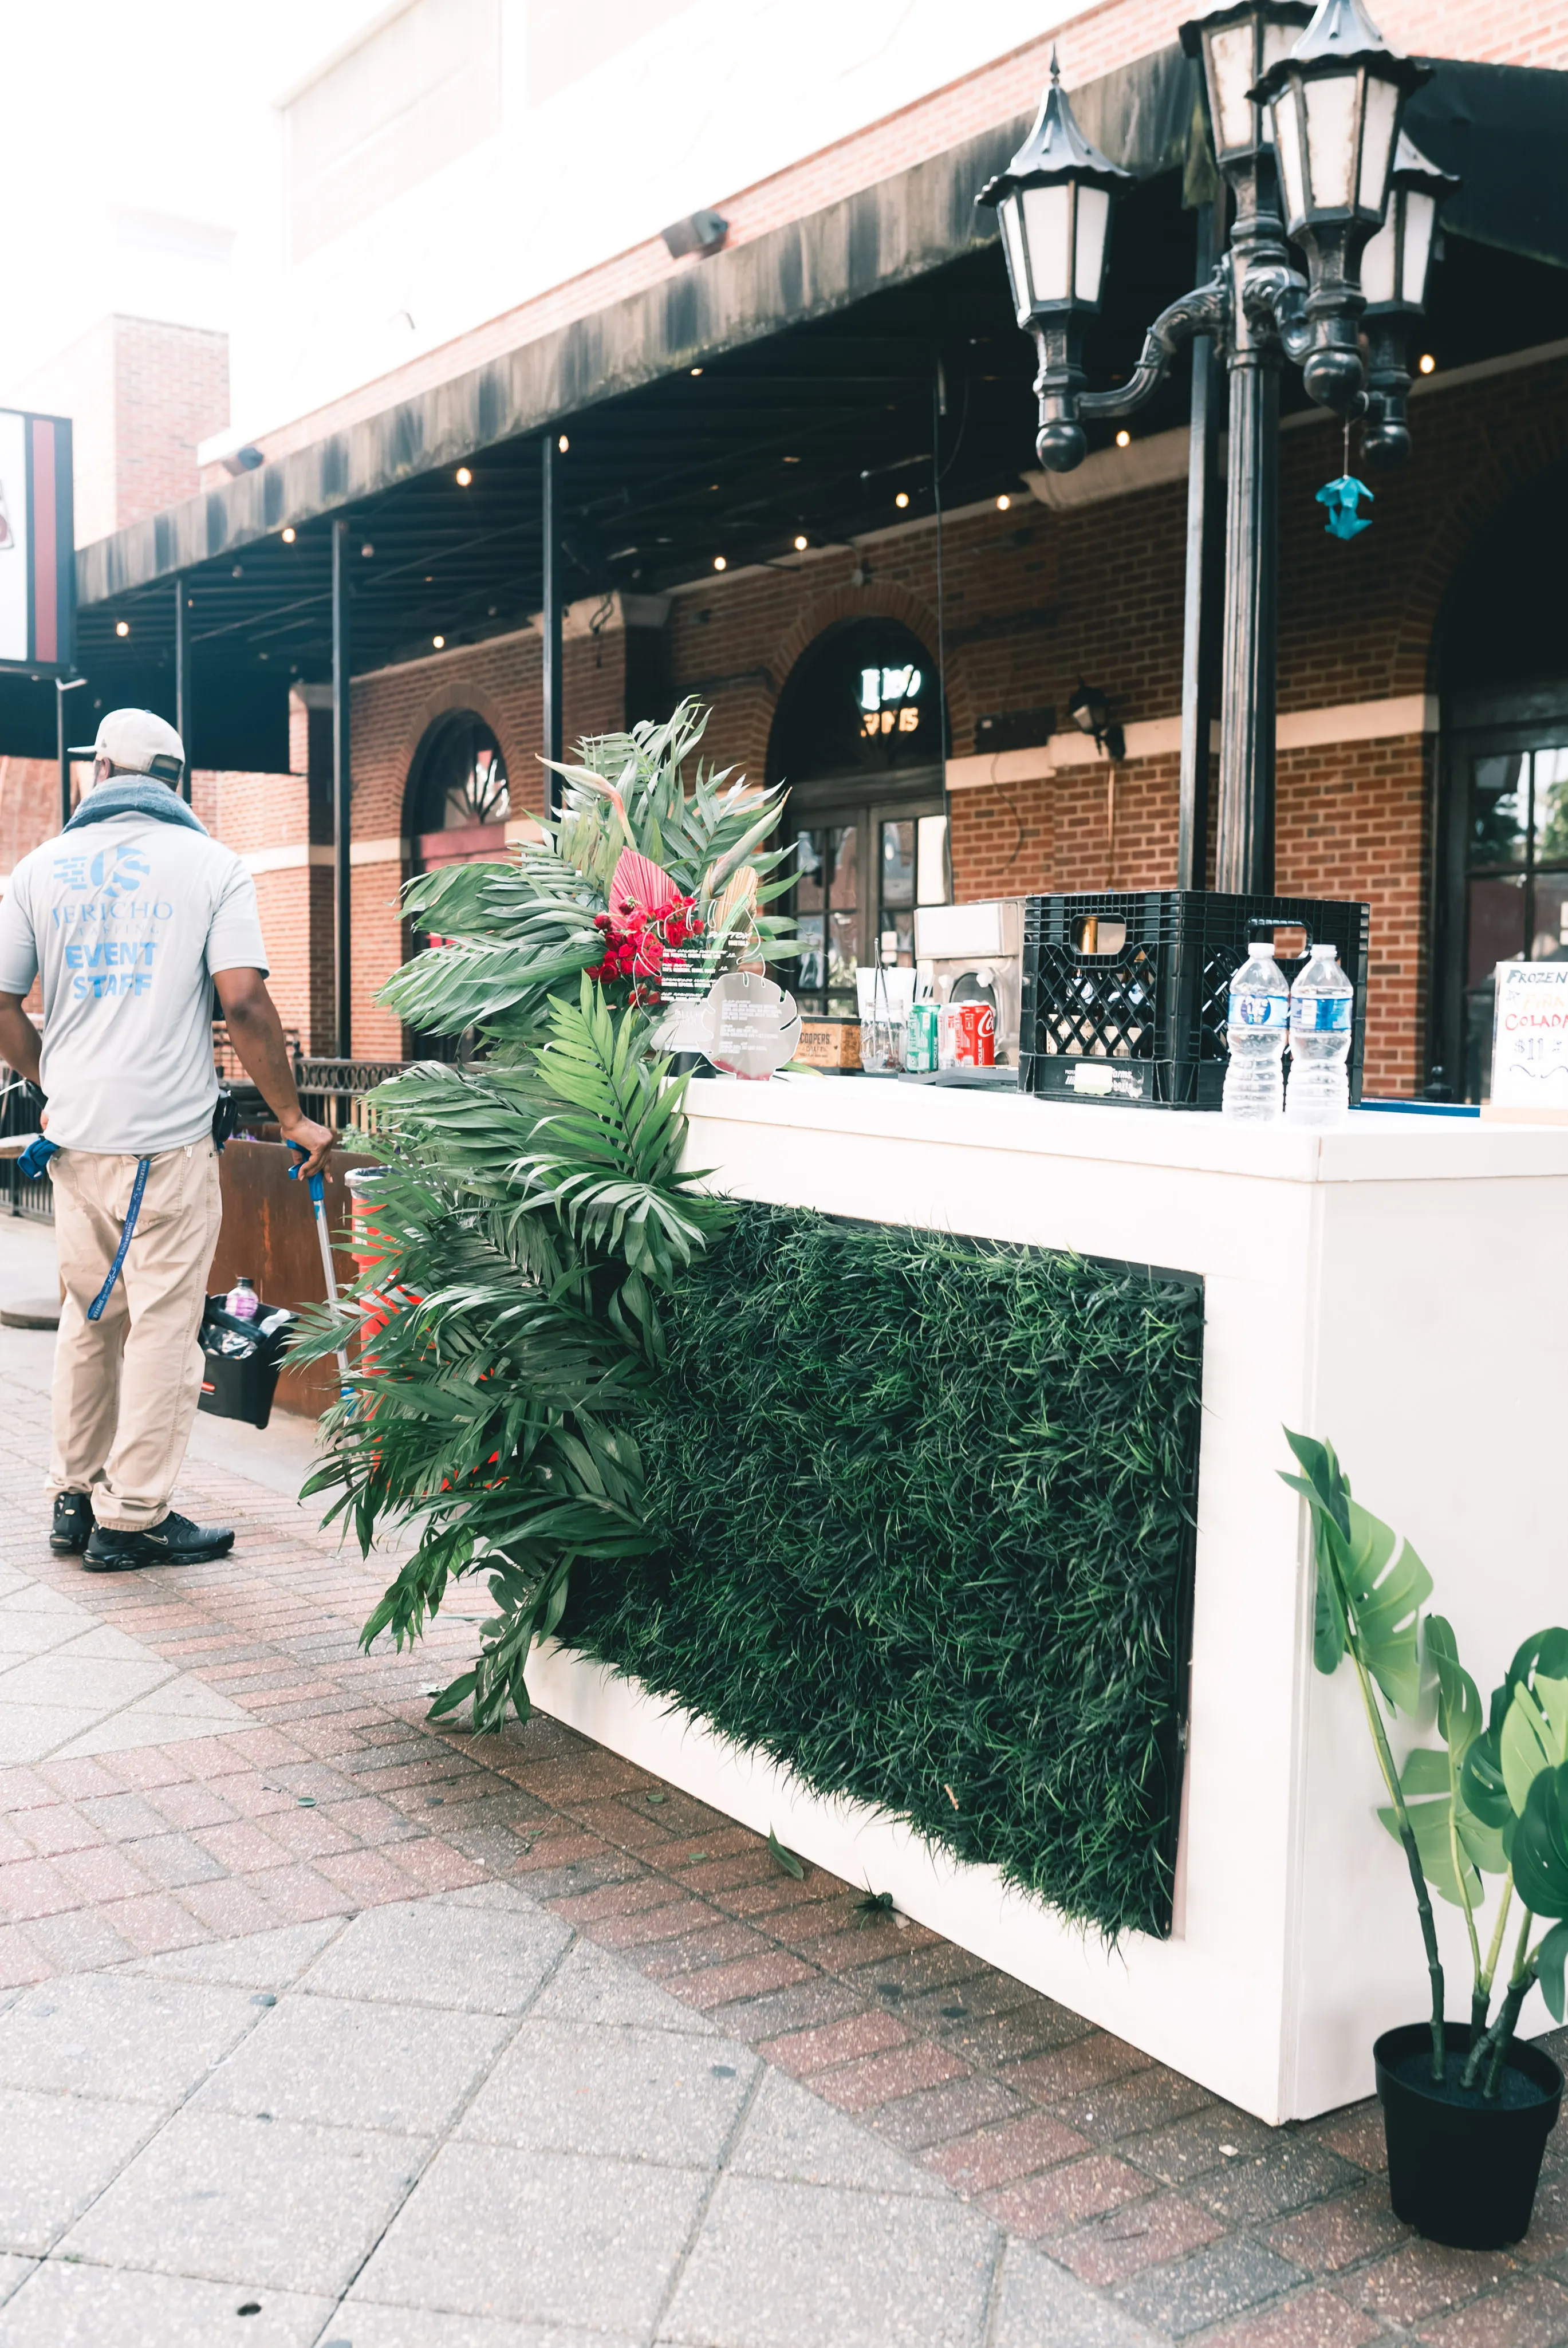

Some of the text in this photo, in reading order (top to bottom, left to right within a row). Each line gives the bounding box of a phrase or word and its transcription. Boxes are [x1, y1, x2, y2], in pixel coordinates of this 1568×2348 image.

[52, 901, 173, 930] JERICHO
[65, 941, 157, 968] EVENT
[73, 972, 152, 1000] STAFF
[1506, 969, 1568, 984] FROZEN
